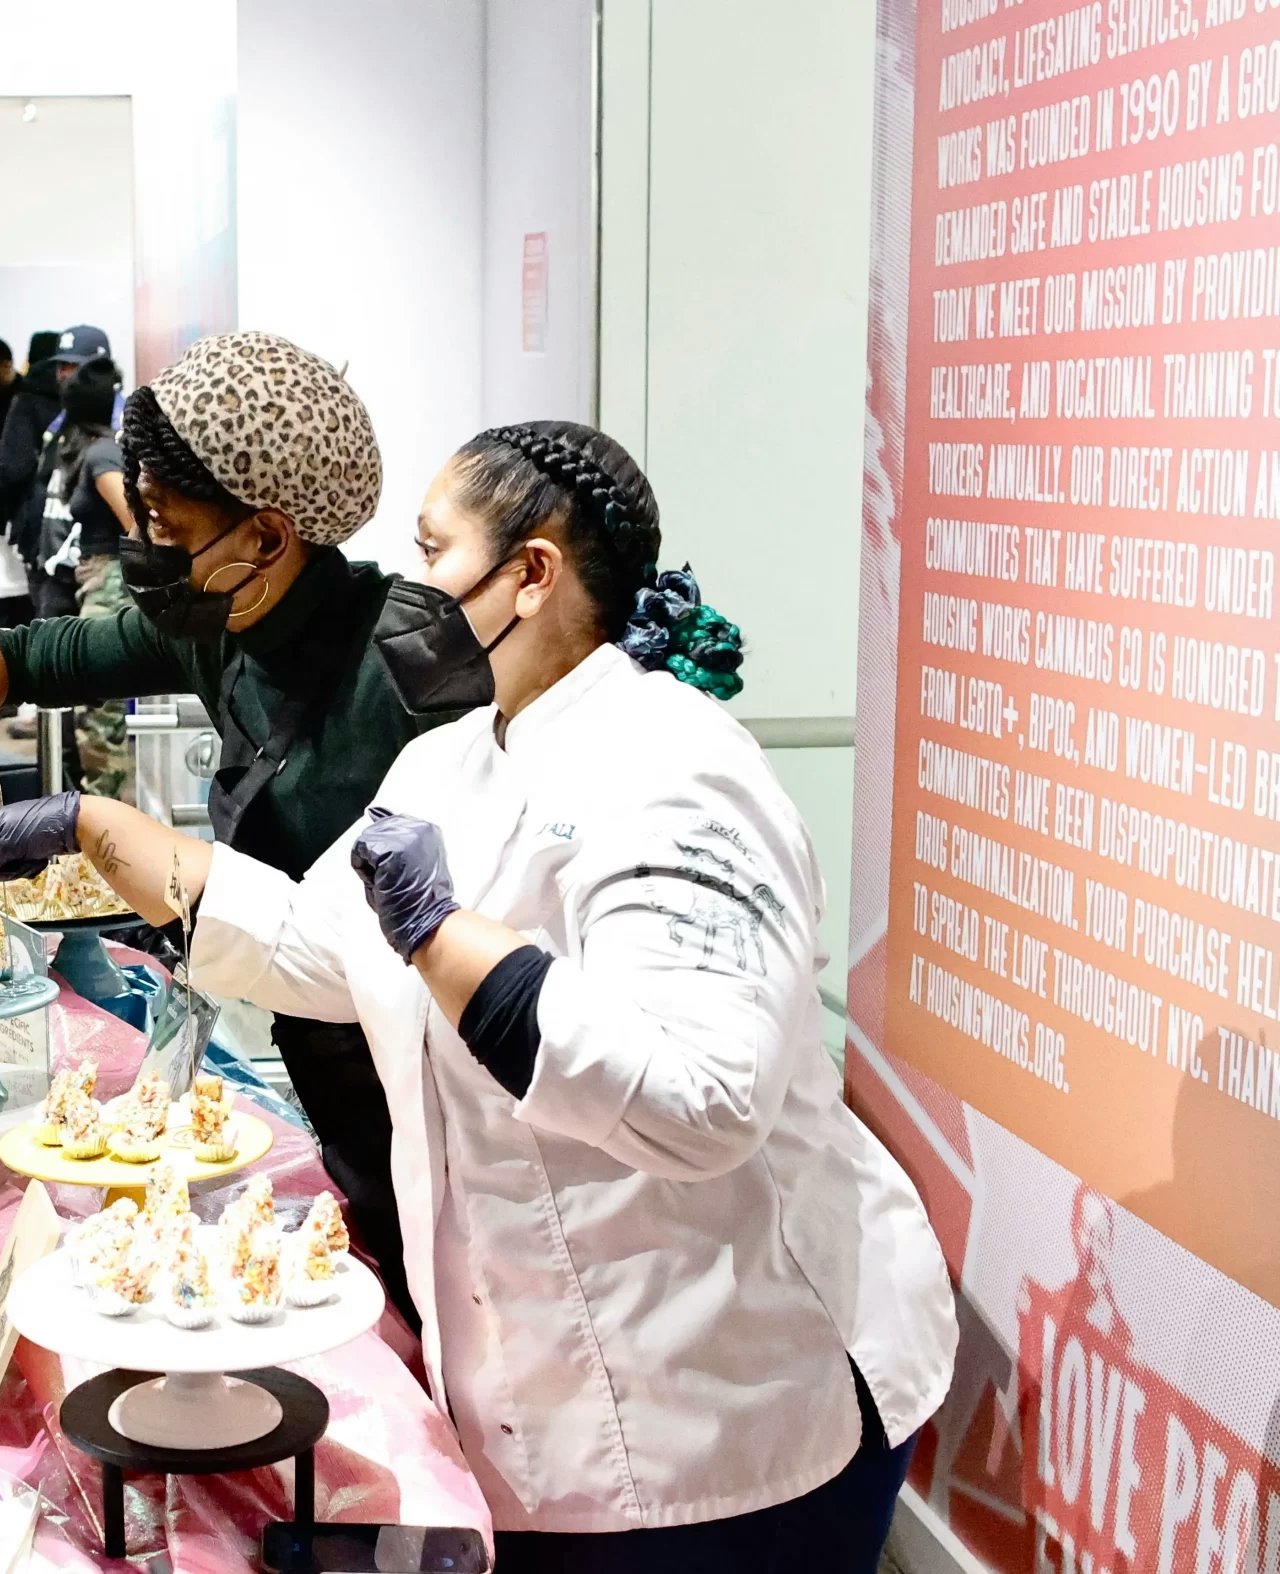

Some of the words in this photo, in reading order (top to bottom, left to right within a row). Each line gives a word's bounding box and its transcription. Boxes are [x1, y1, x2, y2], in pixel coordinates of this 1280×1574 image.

[939, 36, 1010, 112] ADVOCACY,
[1014, 2, 1101, 88] LIFESAVING
[1107, 0, 1198, 59] SERVICES,
[938, 126, 982, 189] WORKS
[987, 116, 1016, 177] WAS
[1021, 95, 1090, 169] FOUNDED
[1096, 88, 1114, 151] IN
[1120, 69, 1179, 146] 1990
[1186, 60, 1212, 131] BY
[1217, 55, 1229, 124] A
[935, 201, 1006, 266] DEMANDED
[1011, 192, 1047, 254] SAFE
[1051, 185, 1083, 248] AND
[1089, 170, 1152, 242] STABLE
[1158, 151, 1244, 231] HOUSING
[1251, 143, 1280, 216] FO
[933, 287, 971, 342] TODAY
[976, 283, 995, 339] WE
[1000, 278, 1040, 337] MEET
[1044, 274, 1075, 334] OUR
[1081, 263, 1156, 330] MISSION
[1162, 259, 1186, 324] BY
[930, 363, 1015, 423] HEALTHCARE,
[1020, 361, 1050, 418] AND
[1057, 356, 1155, 418] VOCATIONAL
[1164, 350, 1253, 418] TRAINING
[929, 442, 983, 497] YORKERS
[987, 445, 1065, 503] ANNUALLY.
[1071, 445, 1103, 505] OUR
[1109, 447, 1173, 510] DIRECT
[1176, 448, 1248, 516] ACTION
[926, 517, 1019, 581] COMMUNITIES
[1025, 527, 1061, 587] THAT
[1065, 532, 1105, 594] HAVE
[1110, 536, 1198, 607] SUFFERED
[1205, 546, 1274, 619] UNDER
[923, 592, 977, 653] HOUSING
[983, 603, 1030, 664] WORKS
[1035, 612, 1114, 683] CANNABIS
[1119, 626, 1142, 690] CO
[1148, 632, 1166, 695] IS
[1172, 636, 1265, 716] HONORED
[921, 665, 956, 723] FROM
[960, 676, 1024, 750] LGBTQ+,
[1029, 693, 1079, 766] BIPOC,
[1085, 708, 1119, 772] AND
[918, 738, 1010, 819] COMMUNITIES
[1014, 771, 1050, 835] HAVE
[1055, 784, 1094, 851] BEEN
[915, 810, 947, 871] DRUG
[951, 826, 1078, 930] CRIMINALIZATION.
[1086, 879, 1127, 951] YOUR
[1132, 899, 1231, 998] PURCHASE
[1237, 940, 1280, 1021] HEL
[909, 953, 925, 1005] AT
[927, 963, 1070, 1094] HOUSINGWORKS.ORG.
[913, 882, 928, 935] TO
[931, 891, 979, 961] SPREAD
[984, 916, 1009, 977] THE
[1013, 931, 1048, 998] LOVE
[1054, 949, 1162, 1056] THROUGHOUT
[1167, 1004, 1209, 1083] NYC.
[1037, 1312, 1147, 1563] LOVE
[1157, 1411, 1280, 1574] PEO
